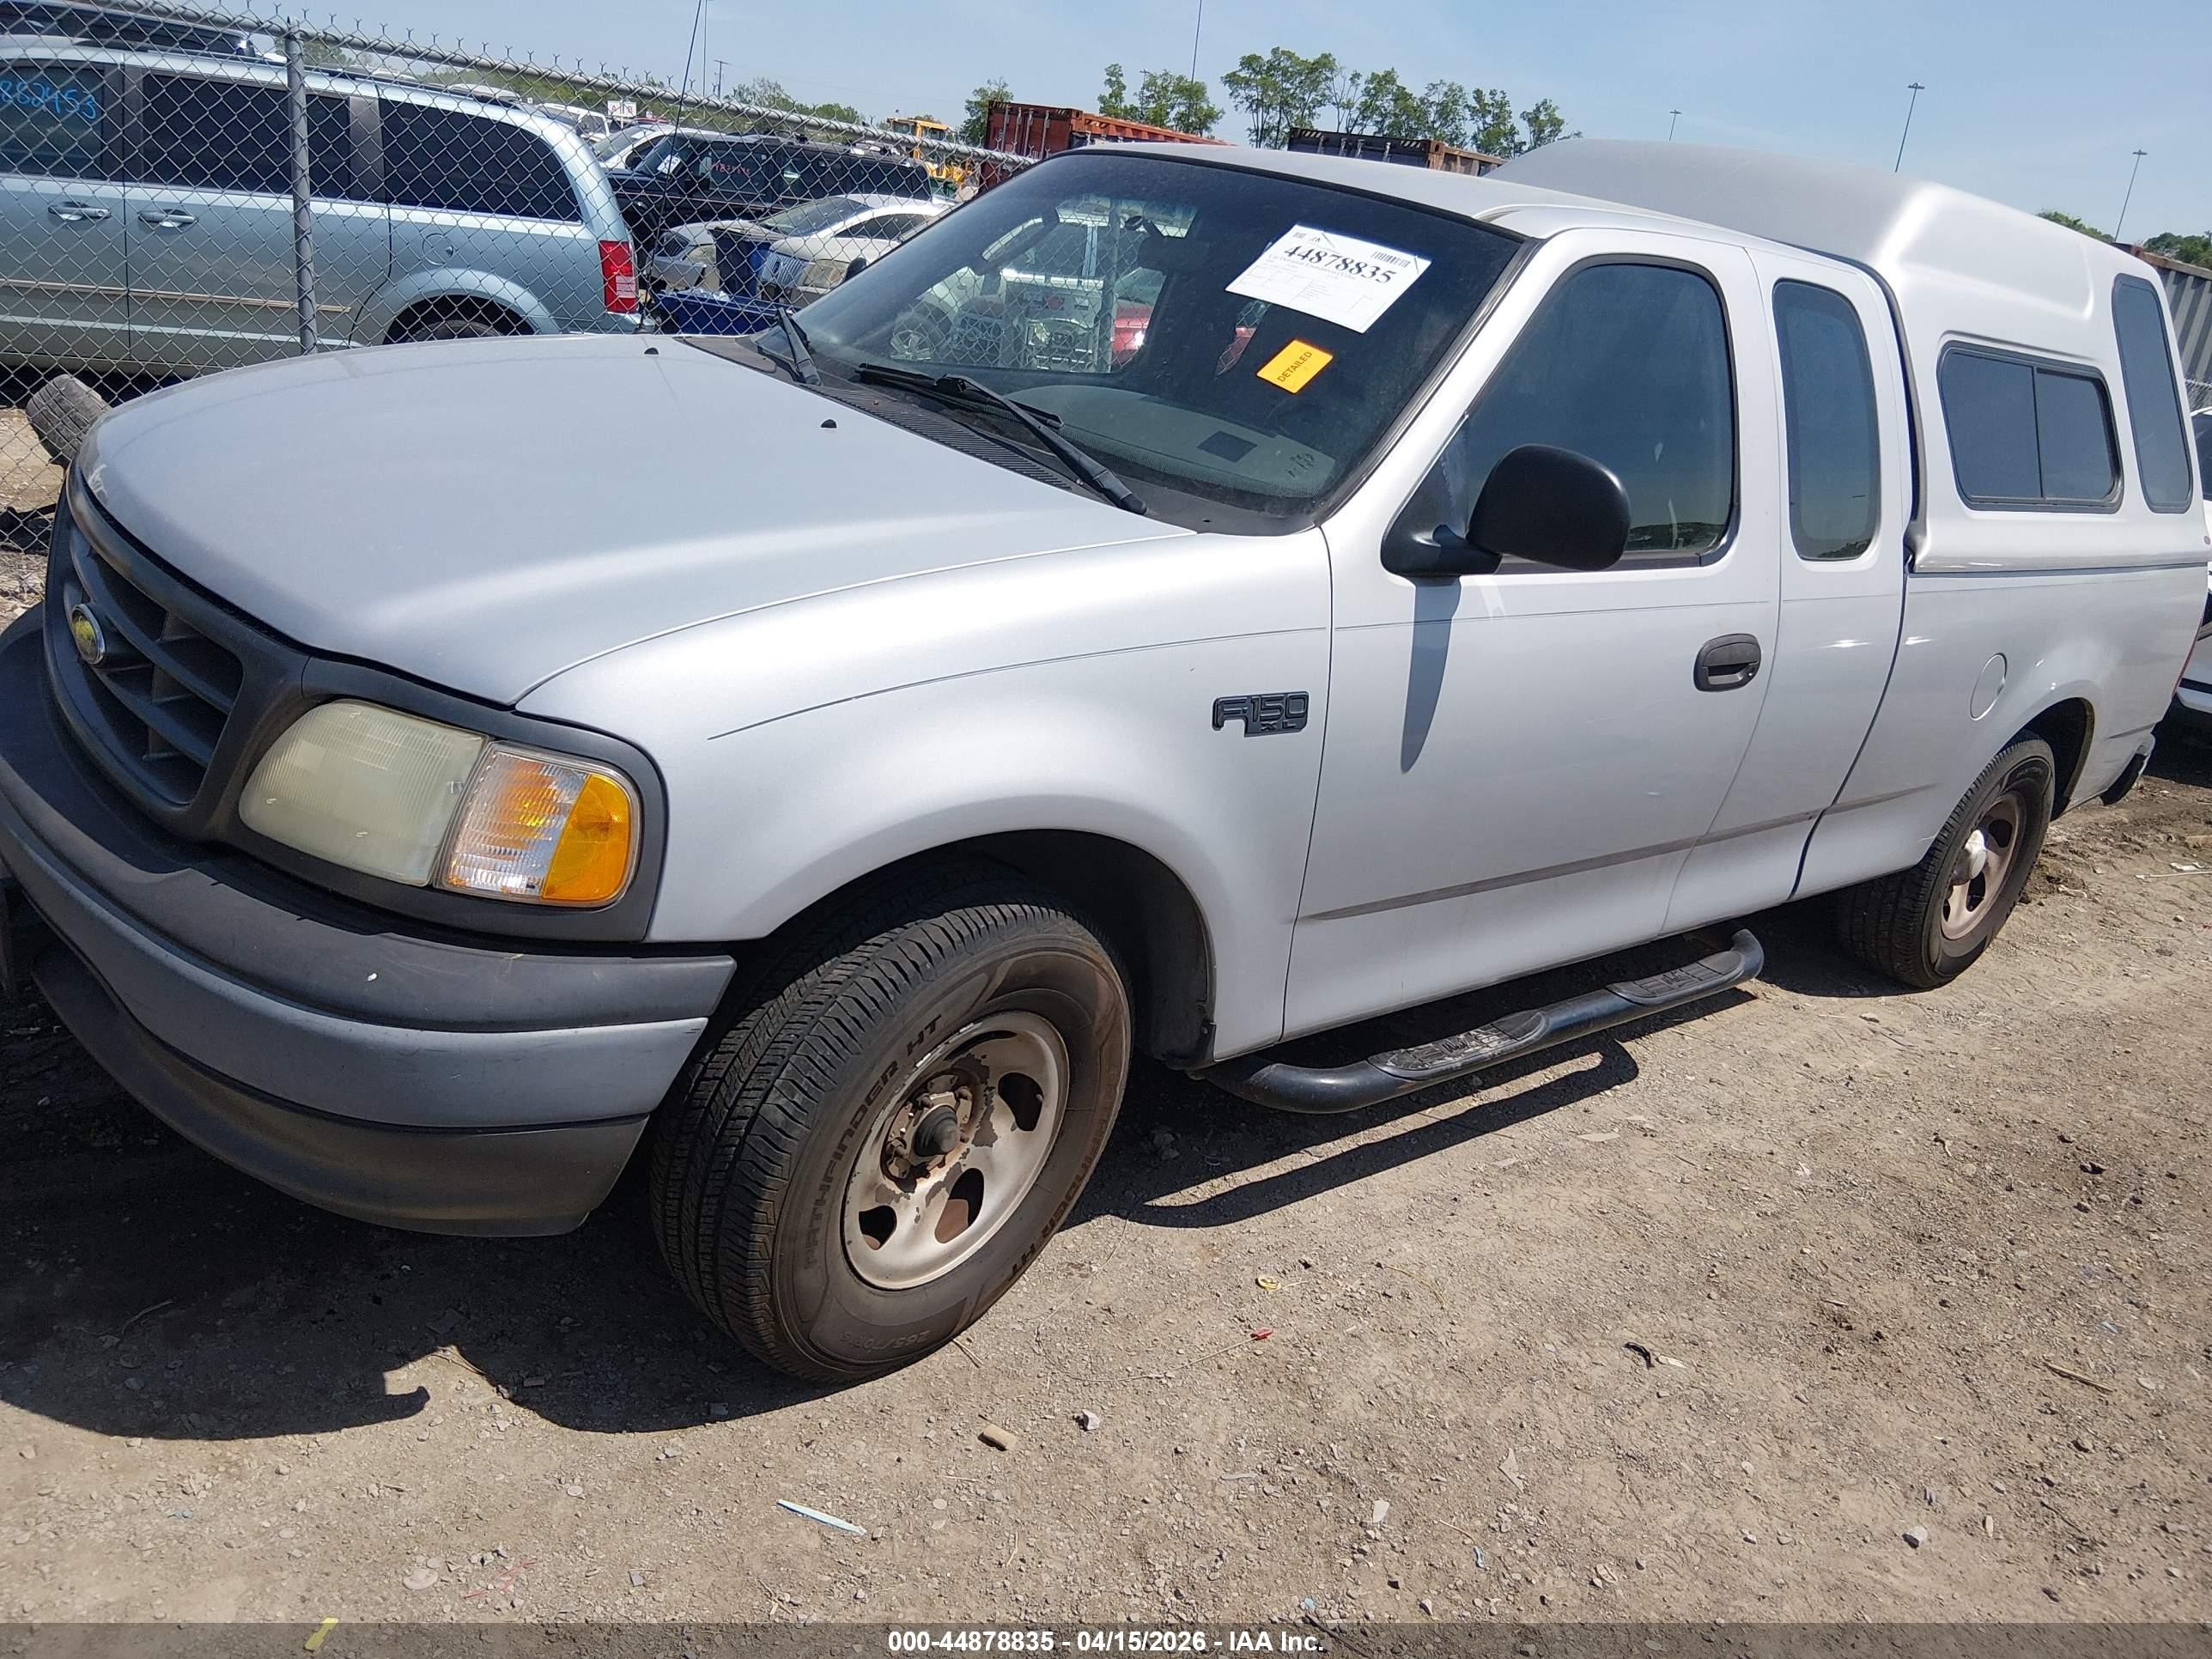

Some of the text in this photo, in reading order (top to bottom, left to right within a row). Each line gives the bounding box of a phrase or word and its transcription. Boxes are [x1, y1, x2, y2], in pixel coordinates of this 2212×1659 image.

[1284, 246, 1397, 283] 44878835
[1278, 351, 1312, 382] DETAILED
[1261, 720, 1297, 732] XL
[804, 1013, 942, 1269] PATHFINDER HT
